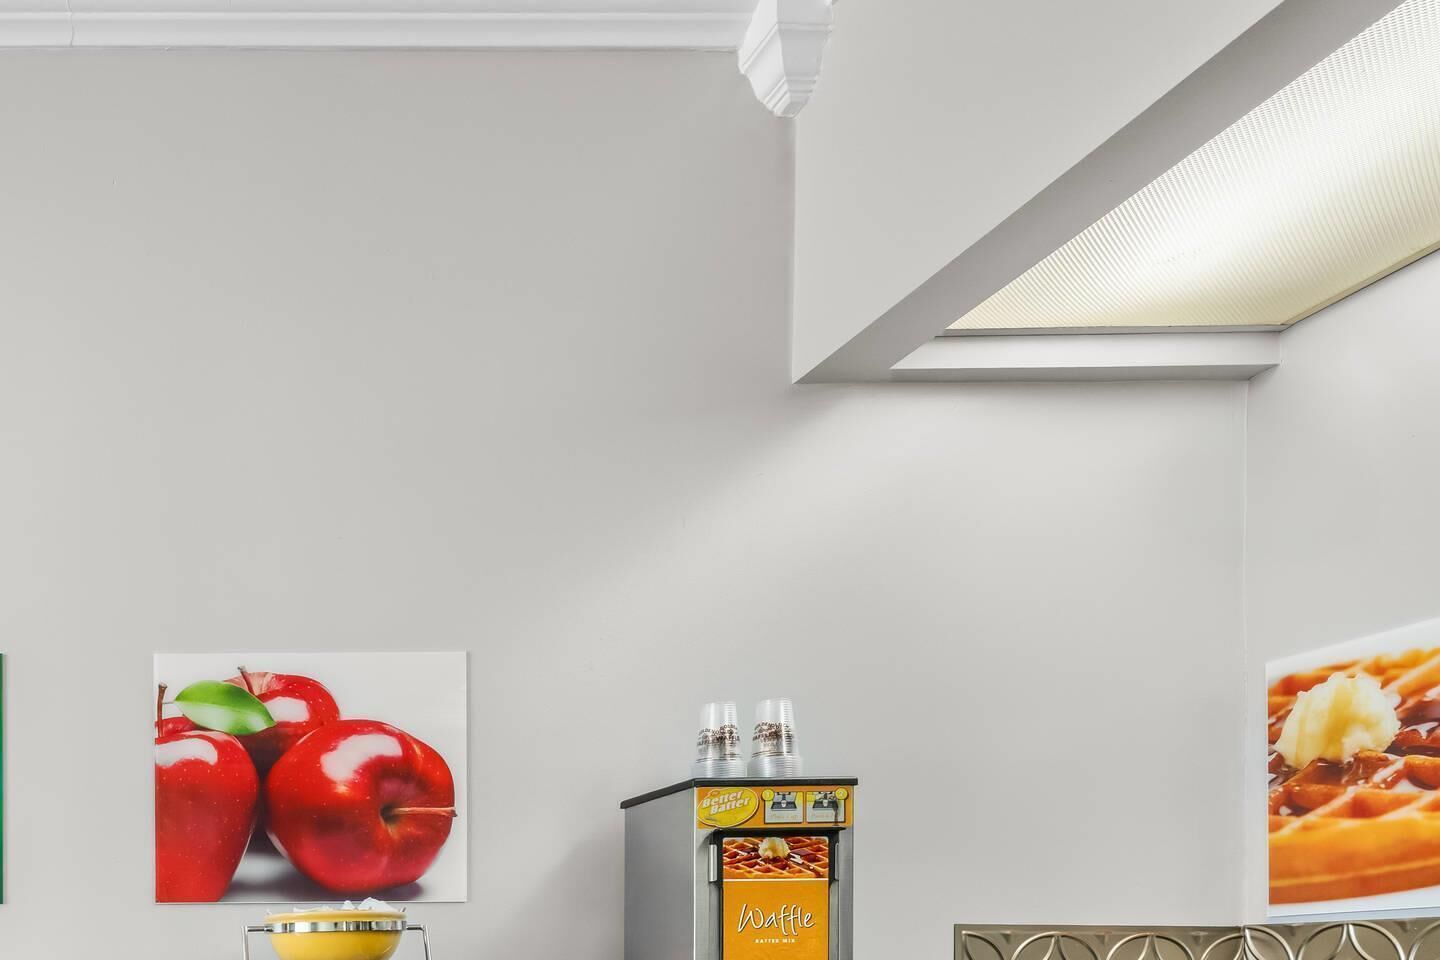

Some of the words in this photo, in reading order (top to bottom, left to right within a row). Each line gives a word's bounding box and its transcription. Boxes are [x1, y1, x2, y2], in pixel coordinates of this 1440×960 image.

[702, 790, 743, 809] Better
[710, 797, 750, 815] Batter
[737, 903, 815, 936] Waffle
